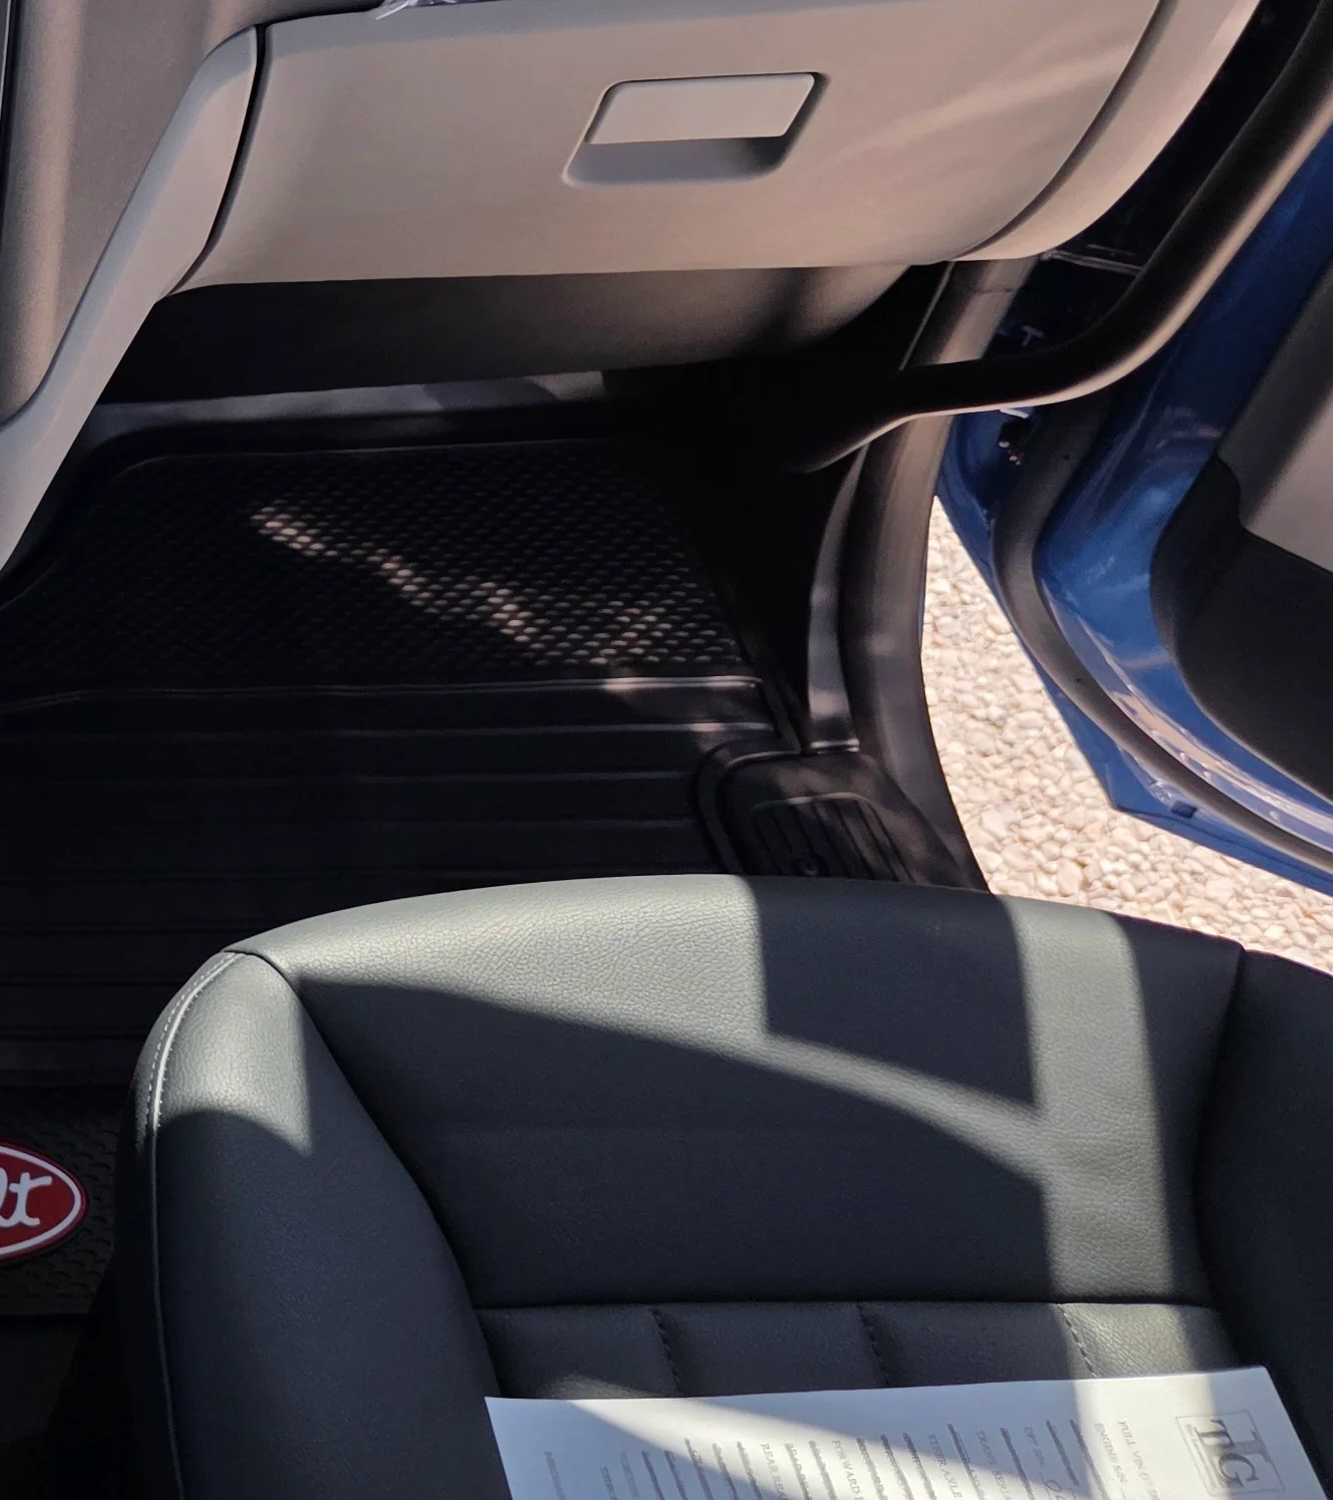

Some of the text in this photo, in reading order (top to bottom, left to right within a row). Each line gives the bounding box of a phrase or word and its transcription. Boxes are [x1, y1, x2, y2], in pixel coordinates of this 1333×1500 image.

[761, 1443, 779, 1476] REAR
[832, 1440, 861, 1494] FORWARD
[941, 1470, 963, 1498] AXLE
